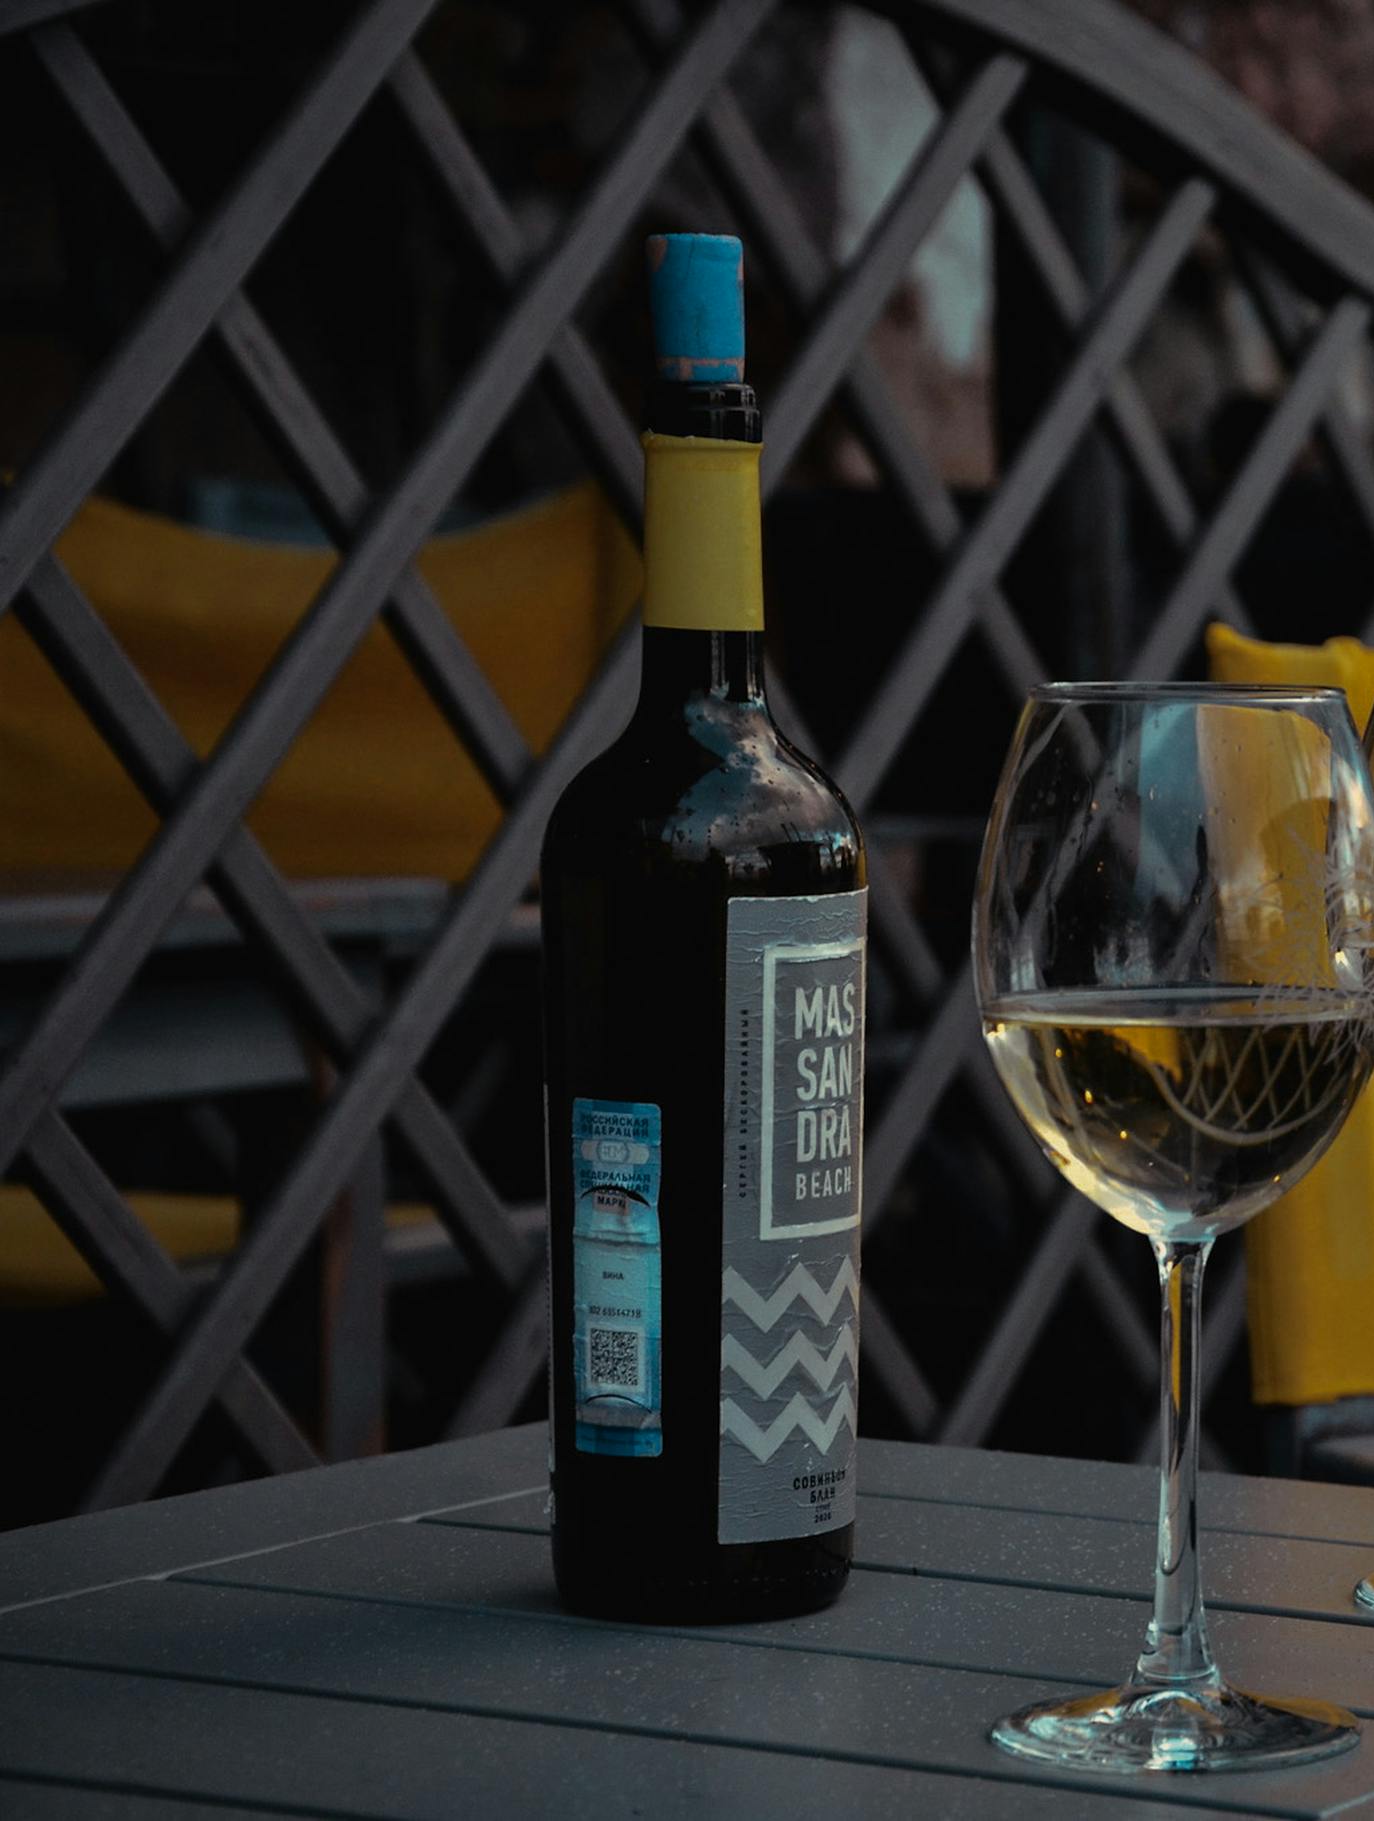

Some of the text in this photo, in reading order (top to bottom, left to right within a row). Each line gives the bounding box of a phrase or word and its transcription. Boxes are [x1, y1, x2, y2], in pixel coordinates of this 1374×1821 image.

[794, 982, 855, 1040] MAS
[796, 1043, 853, 1102] SAN
[796, 1104, 853, 1163] DRA
[795, 1166, 853, 1201] BEACH
